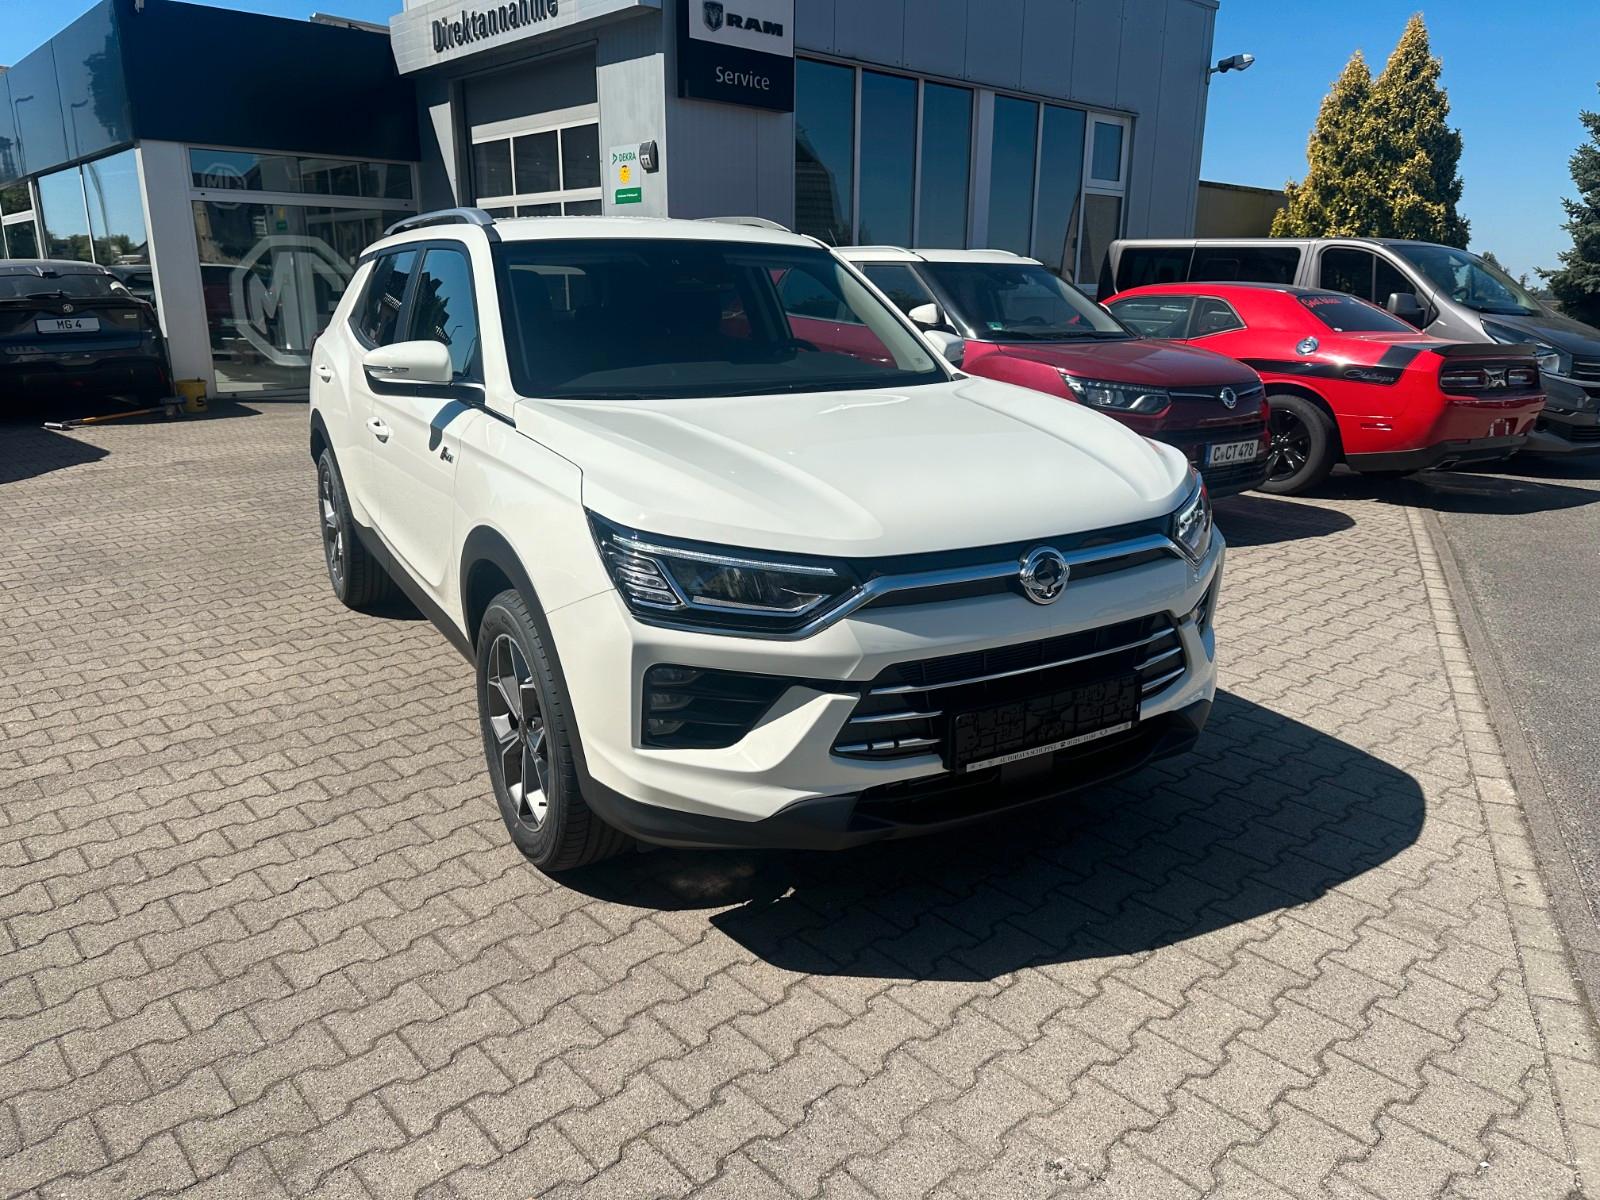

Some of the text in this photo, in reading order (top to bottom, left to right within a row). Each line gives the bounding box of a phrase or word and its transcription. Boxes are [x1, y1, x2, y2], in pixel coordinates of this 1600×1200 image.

[432, 0, 559, 53] Direktannahme
[726, 13, 783, 37] RAM
[716, 66, 770, 90] Service
[619, 152, 636, 162] DEKRA
[57, 319, 82, 329] MG 4
